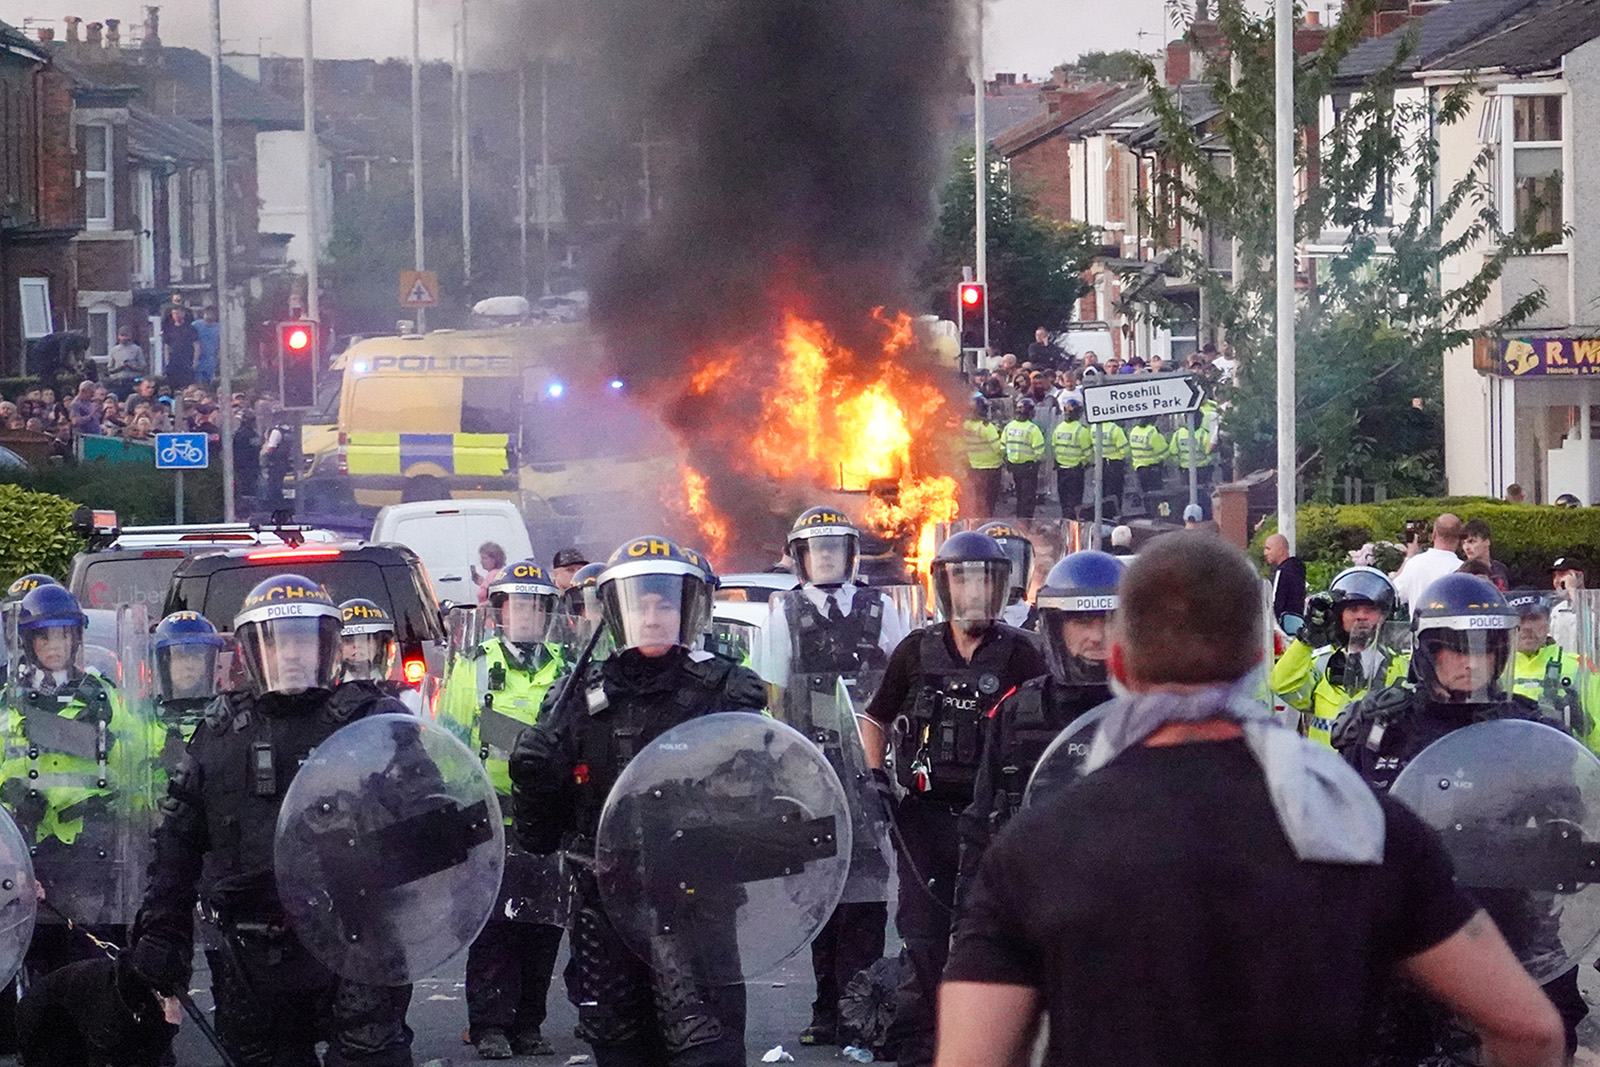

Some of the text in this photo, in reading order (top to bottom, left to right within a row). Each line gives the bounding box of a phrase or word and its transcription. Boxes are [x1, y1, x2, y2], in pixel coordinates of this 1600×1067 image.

[1545, 341, 1568, 365] R.
[372, 355, 514, 371] POLICE
[1110, 385, 1161, 401] Rosehill
[1092, 396, 1182, 417] Business Park
[810, 527, 833, 535] POLICE
[628, 540, 670, 557] CH
[513, 565, 542, 579] CH
[267, 585, 304, 601] CH
[515, 585, 539, 593] POLICE
[1077, 598, 1113, 609] POLICE
[1509, 595, 1535, 607] POLICE
[268, 604, 303, 618] POLICE
[342, 625, 366, 634] POLICE
[1469, 617, 1503, 628] POLICE
